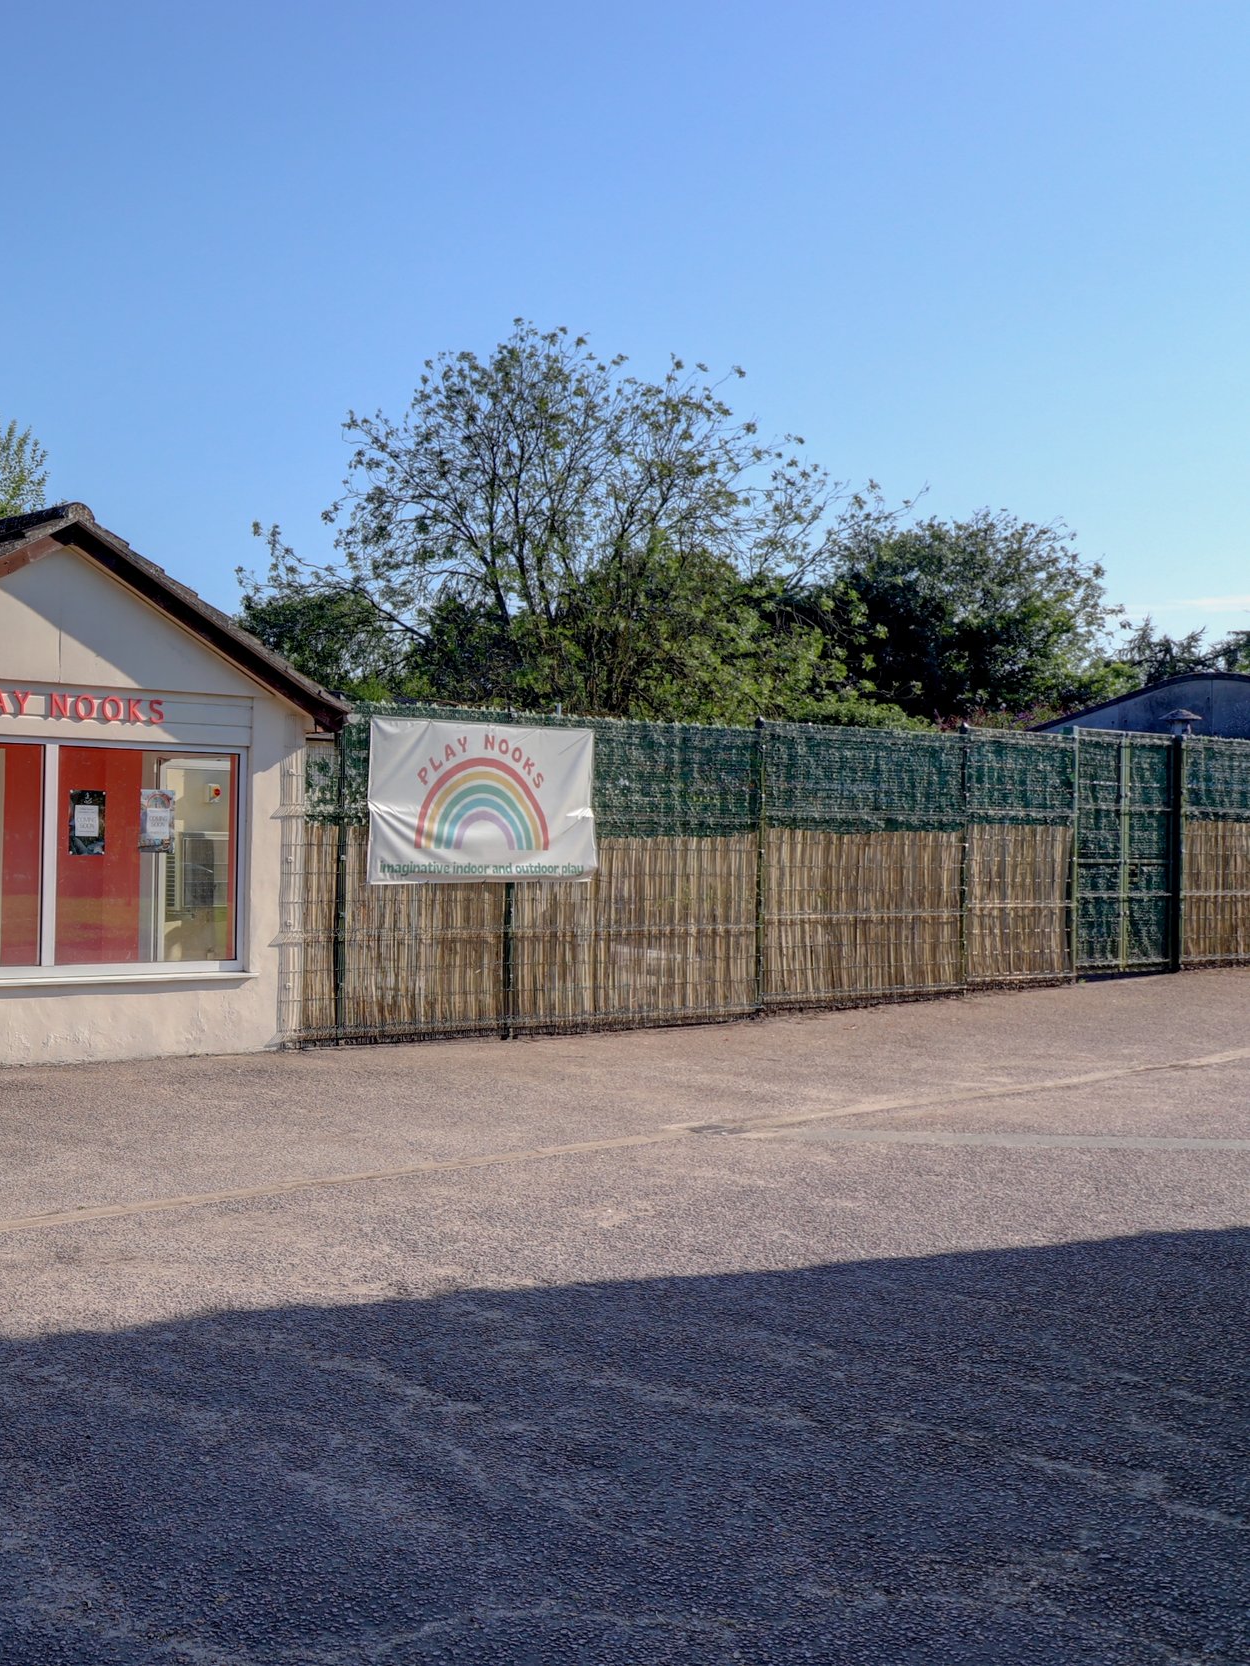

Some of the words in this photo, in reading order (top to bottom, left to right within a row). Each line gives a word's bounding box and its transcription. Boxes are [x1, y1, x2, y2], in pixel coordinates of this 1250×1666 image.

[50, 692, 165, 724] NOOKS
[417, 736, 468, 785] PLAY
[484, 734, 544, 789] NOOKS
[380, 861, 449, 876] imaginative
[453, 862, 490, 874] indoor
[492, 862, 512, 874] and
[515, 862, 558, 874] outdoor
[561, 862, 584, 876] play
